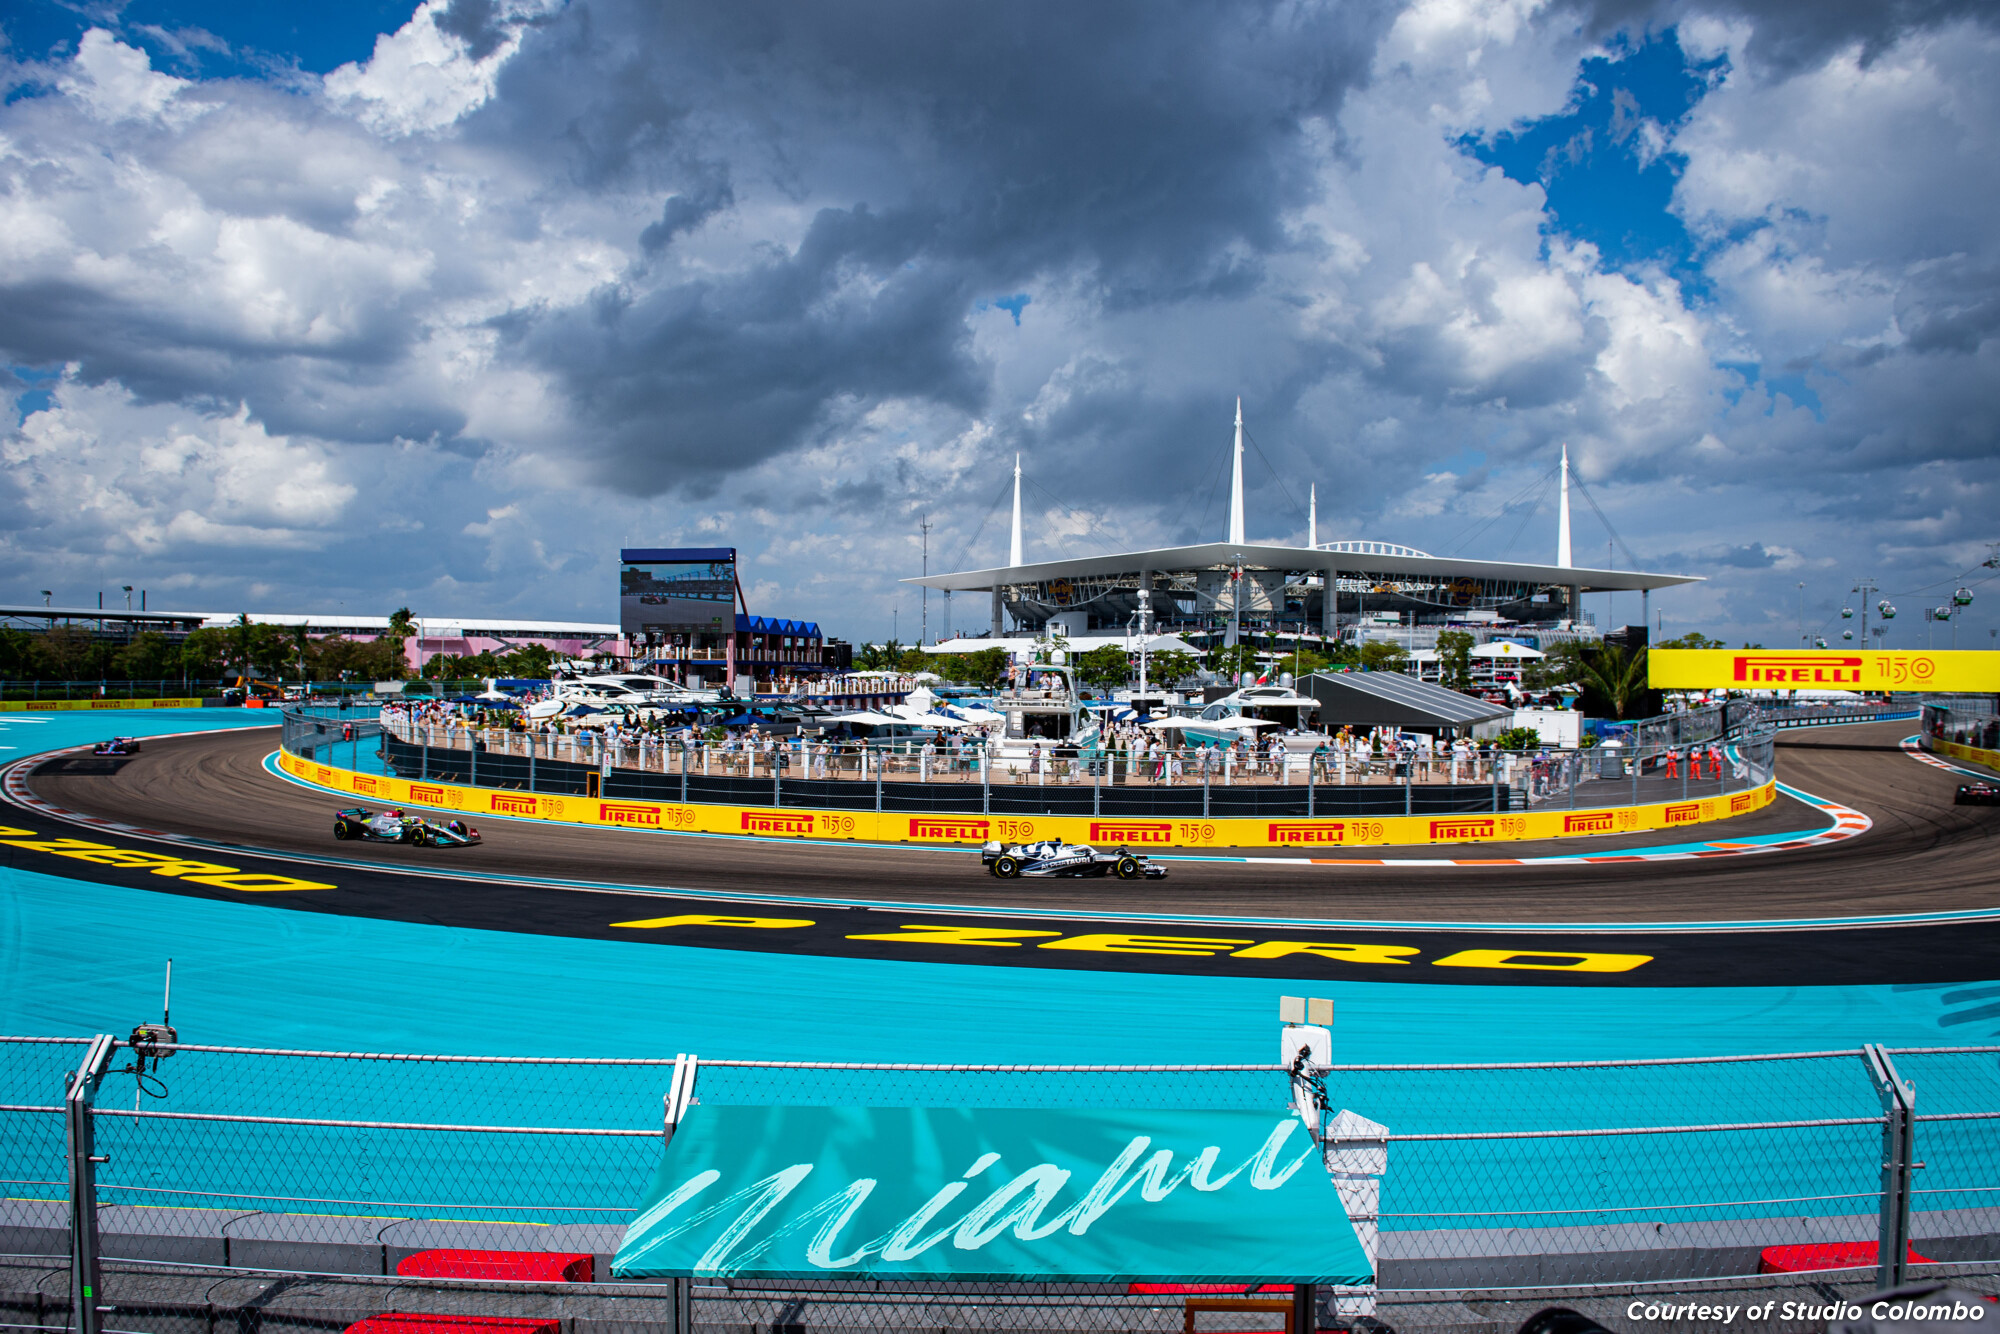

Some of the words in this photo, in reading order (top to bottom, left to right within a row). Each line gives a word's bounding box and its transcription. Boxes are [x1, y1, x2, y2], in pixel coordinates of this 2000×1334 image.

[1734, 657, 1863, 682] PIRELLI
[1876, 657, 1936, 684] 150
[353, 776, 377, 794] PIRELLI
[410, 785, 444, 804] PIRELLI
[447, 789, 464, 806] 150
[491, 794, 537, 814] PIRELLI
[541, 798, 564, 816] 150
[600, 804, 661, 825] PIRELLI
[667, 808, 696, 827] 150
[1665, 804, 1699, 823] PIRELLI
[741, 812, 814, 833] PIRELLI
[821, 815, 855, 834] 150
[909, 819, 990, 839] PIRELLI
[997, 821, 1034, 839] 150
[1090, 822, 1172, 842] PIRELLI
[1180, 824, 1215, 840] 150
[1268, 823, 1345, 842] PIRELLI
[1351, 822, 1384, 841] 150
[1430, 819, 1495, 839] PIRELLI
[1500, 818, 1526, 836] 150
[1564, 813, 1613, 832] PIRELLI
[1617, 811, 1638, 826] 150
[0, 838, 338, 892] ZERO
[610, 914, 816, 929] P
[845, 924, 1654, 973] ZERO
[606, 1109, 1316, 1278] Miami
